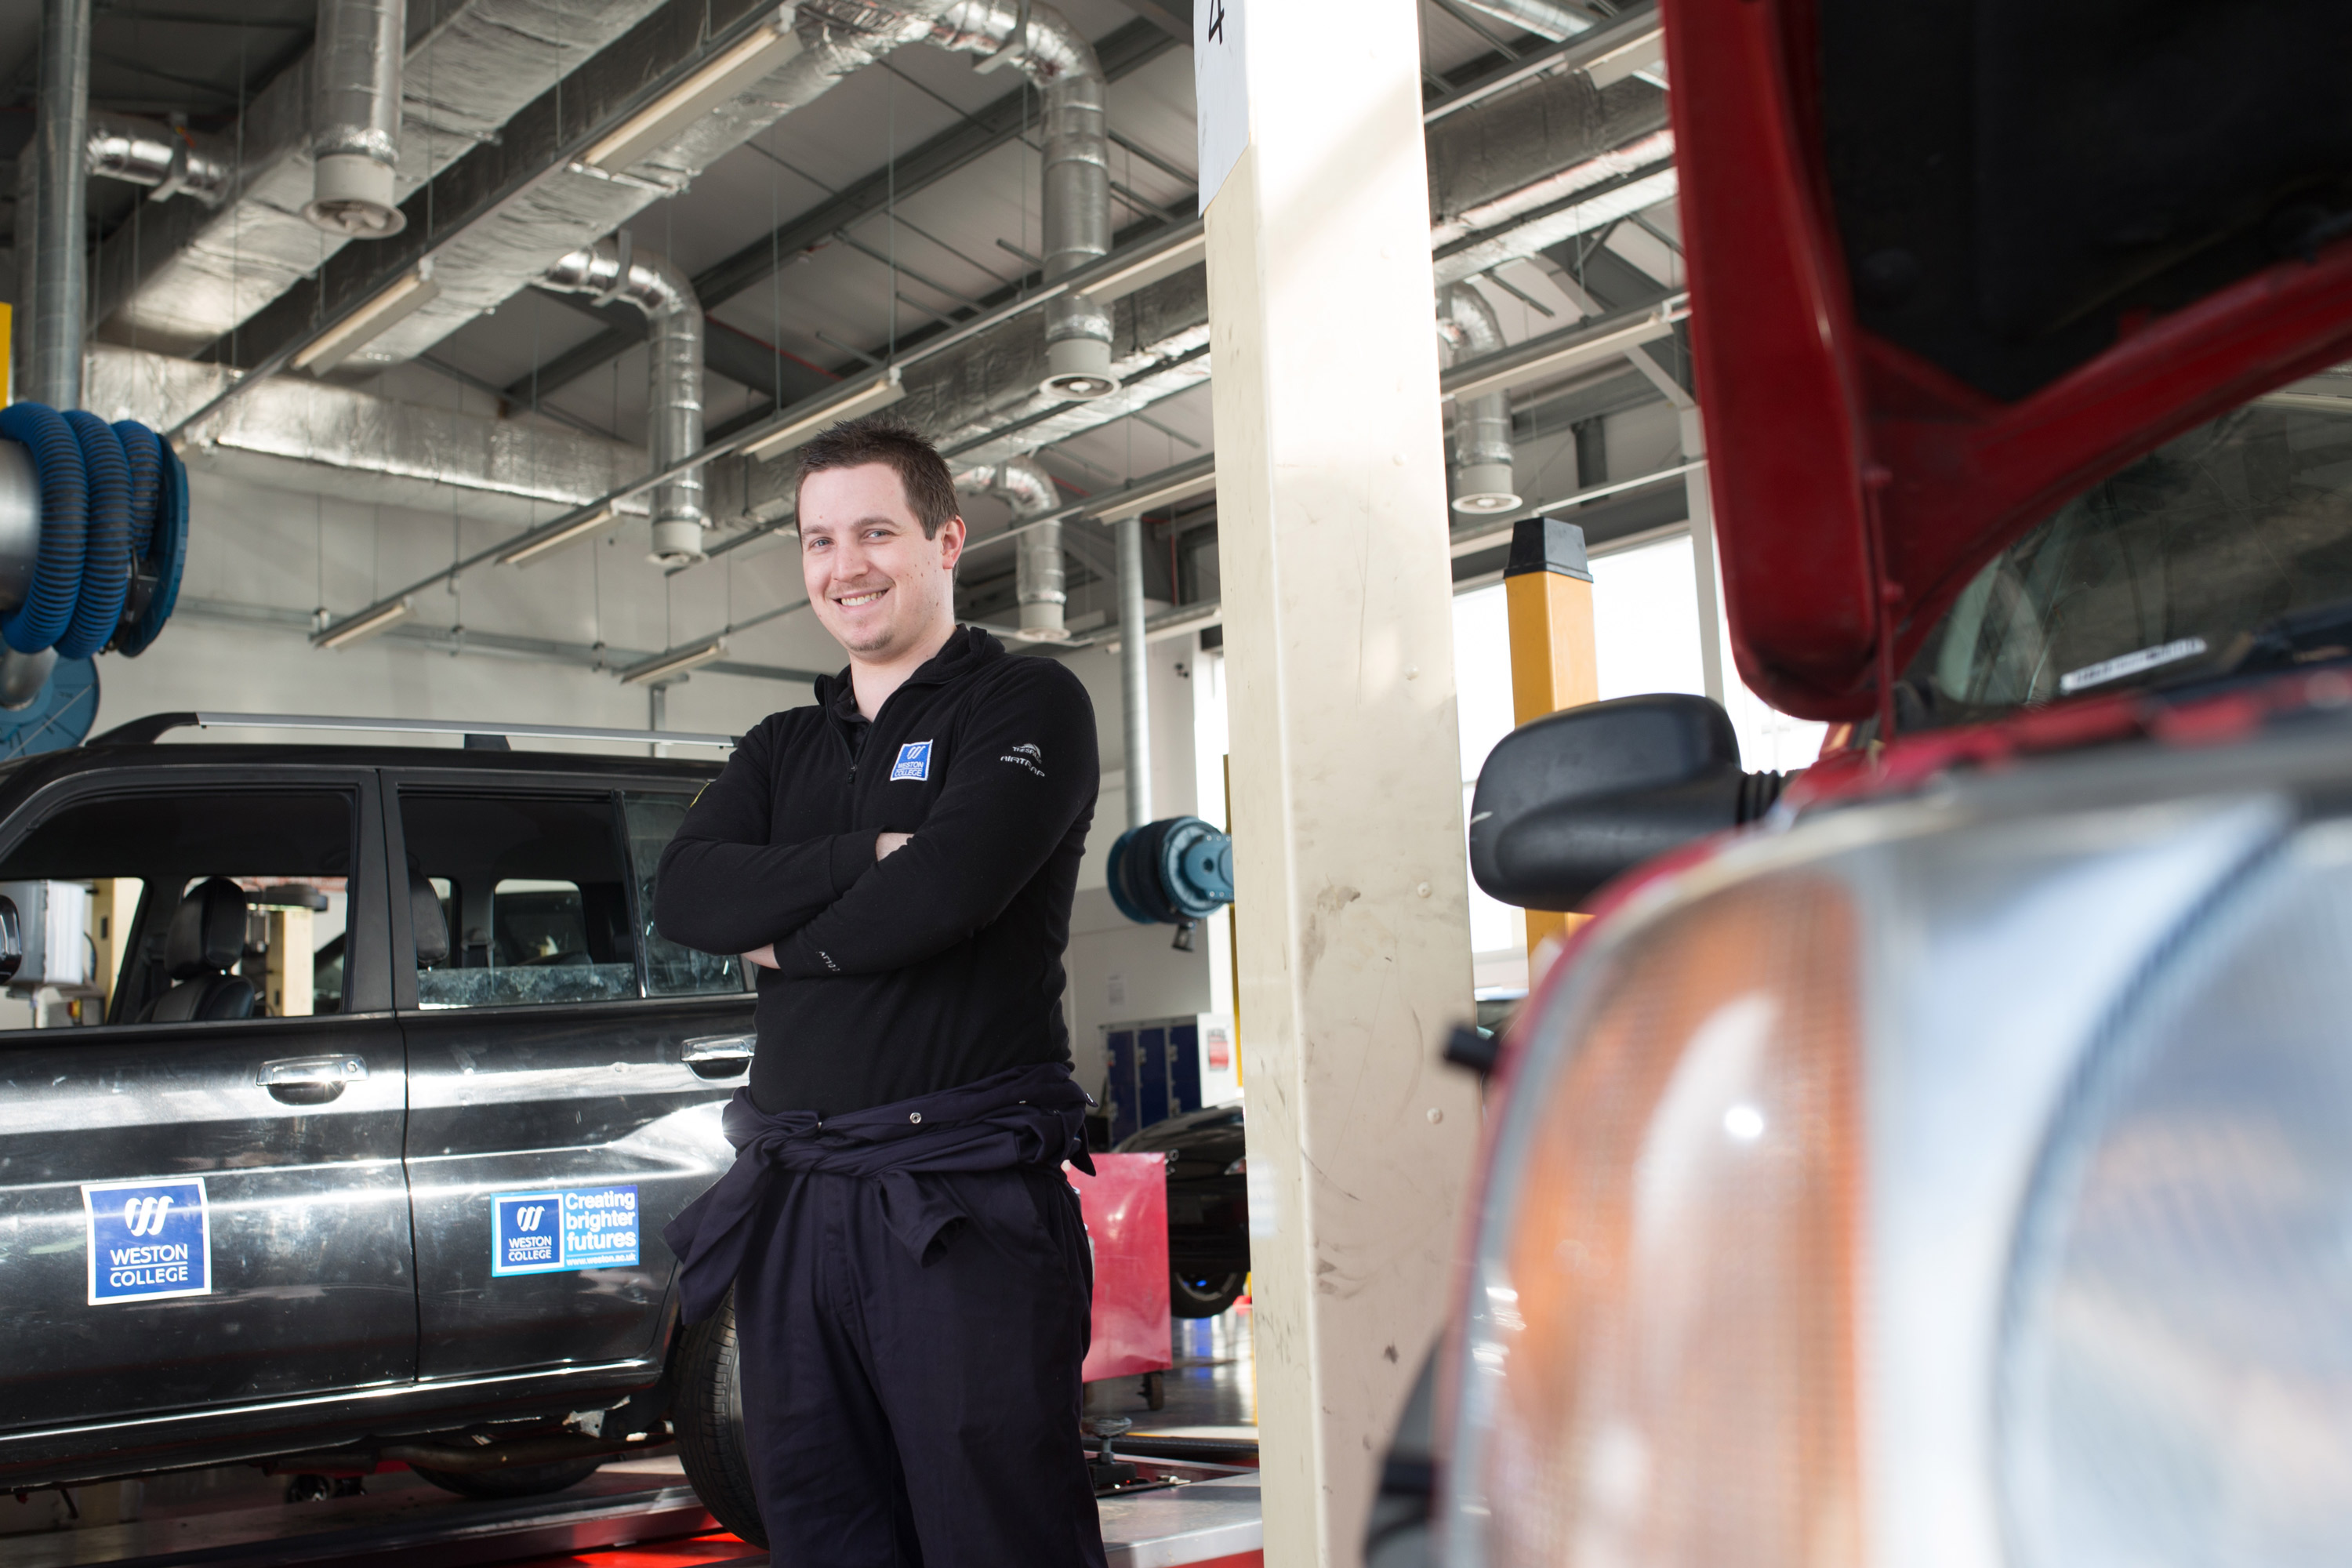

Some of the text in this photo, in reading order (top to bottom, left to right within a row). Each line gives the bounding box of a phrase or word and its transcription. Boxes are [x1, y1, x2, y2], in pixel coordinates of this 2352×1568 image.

[565, 1190, 636, 1210] Creating
[566, 1210, 636, 1232] brighter
[508, 1236, 552, 1248] WESTON
[566, 1231, 637, 1251] futures
[110, 1243, 188, 1265] WESTON
[508, 1249, 552, 1261] COLLEGE
[566, 1253, 636, 1266] www.weston.ac.uk
[110, 1266, 188, 1287] COLLEGE
